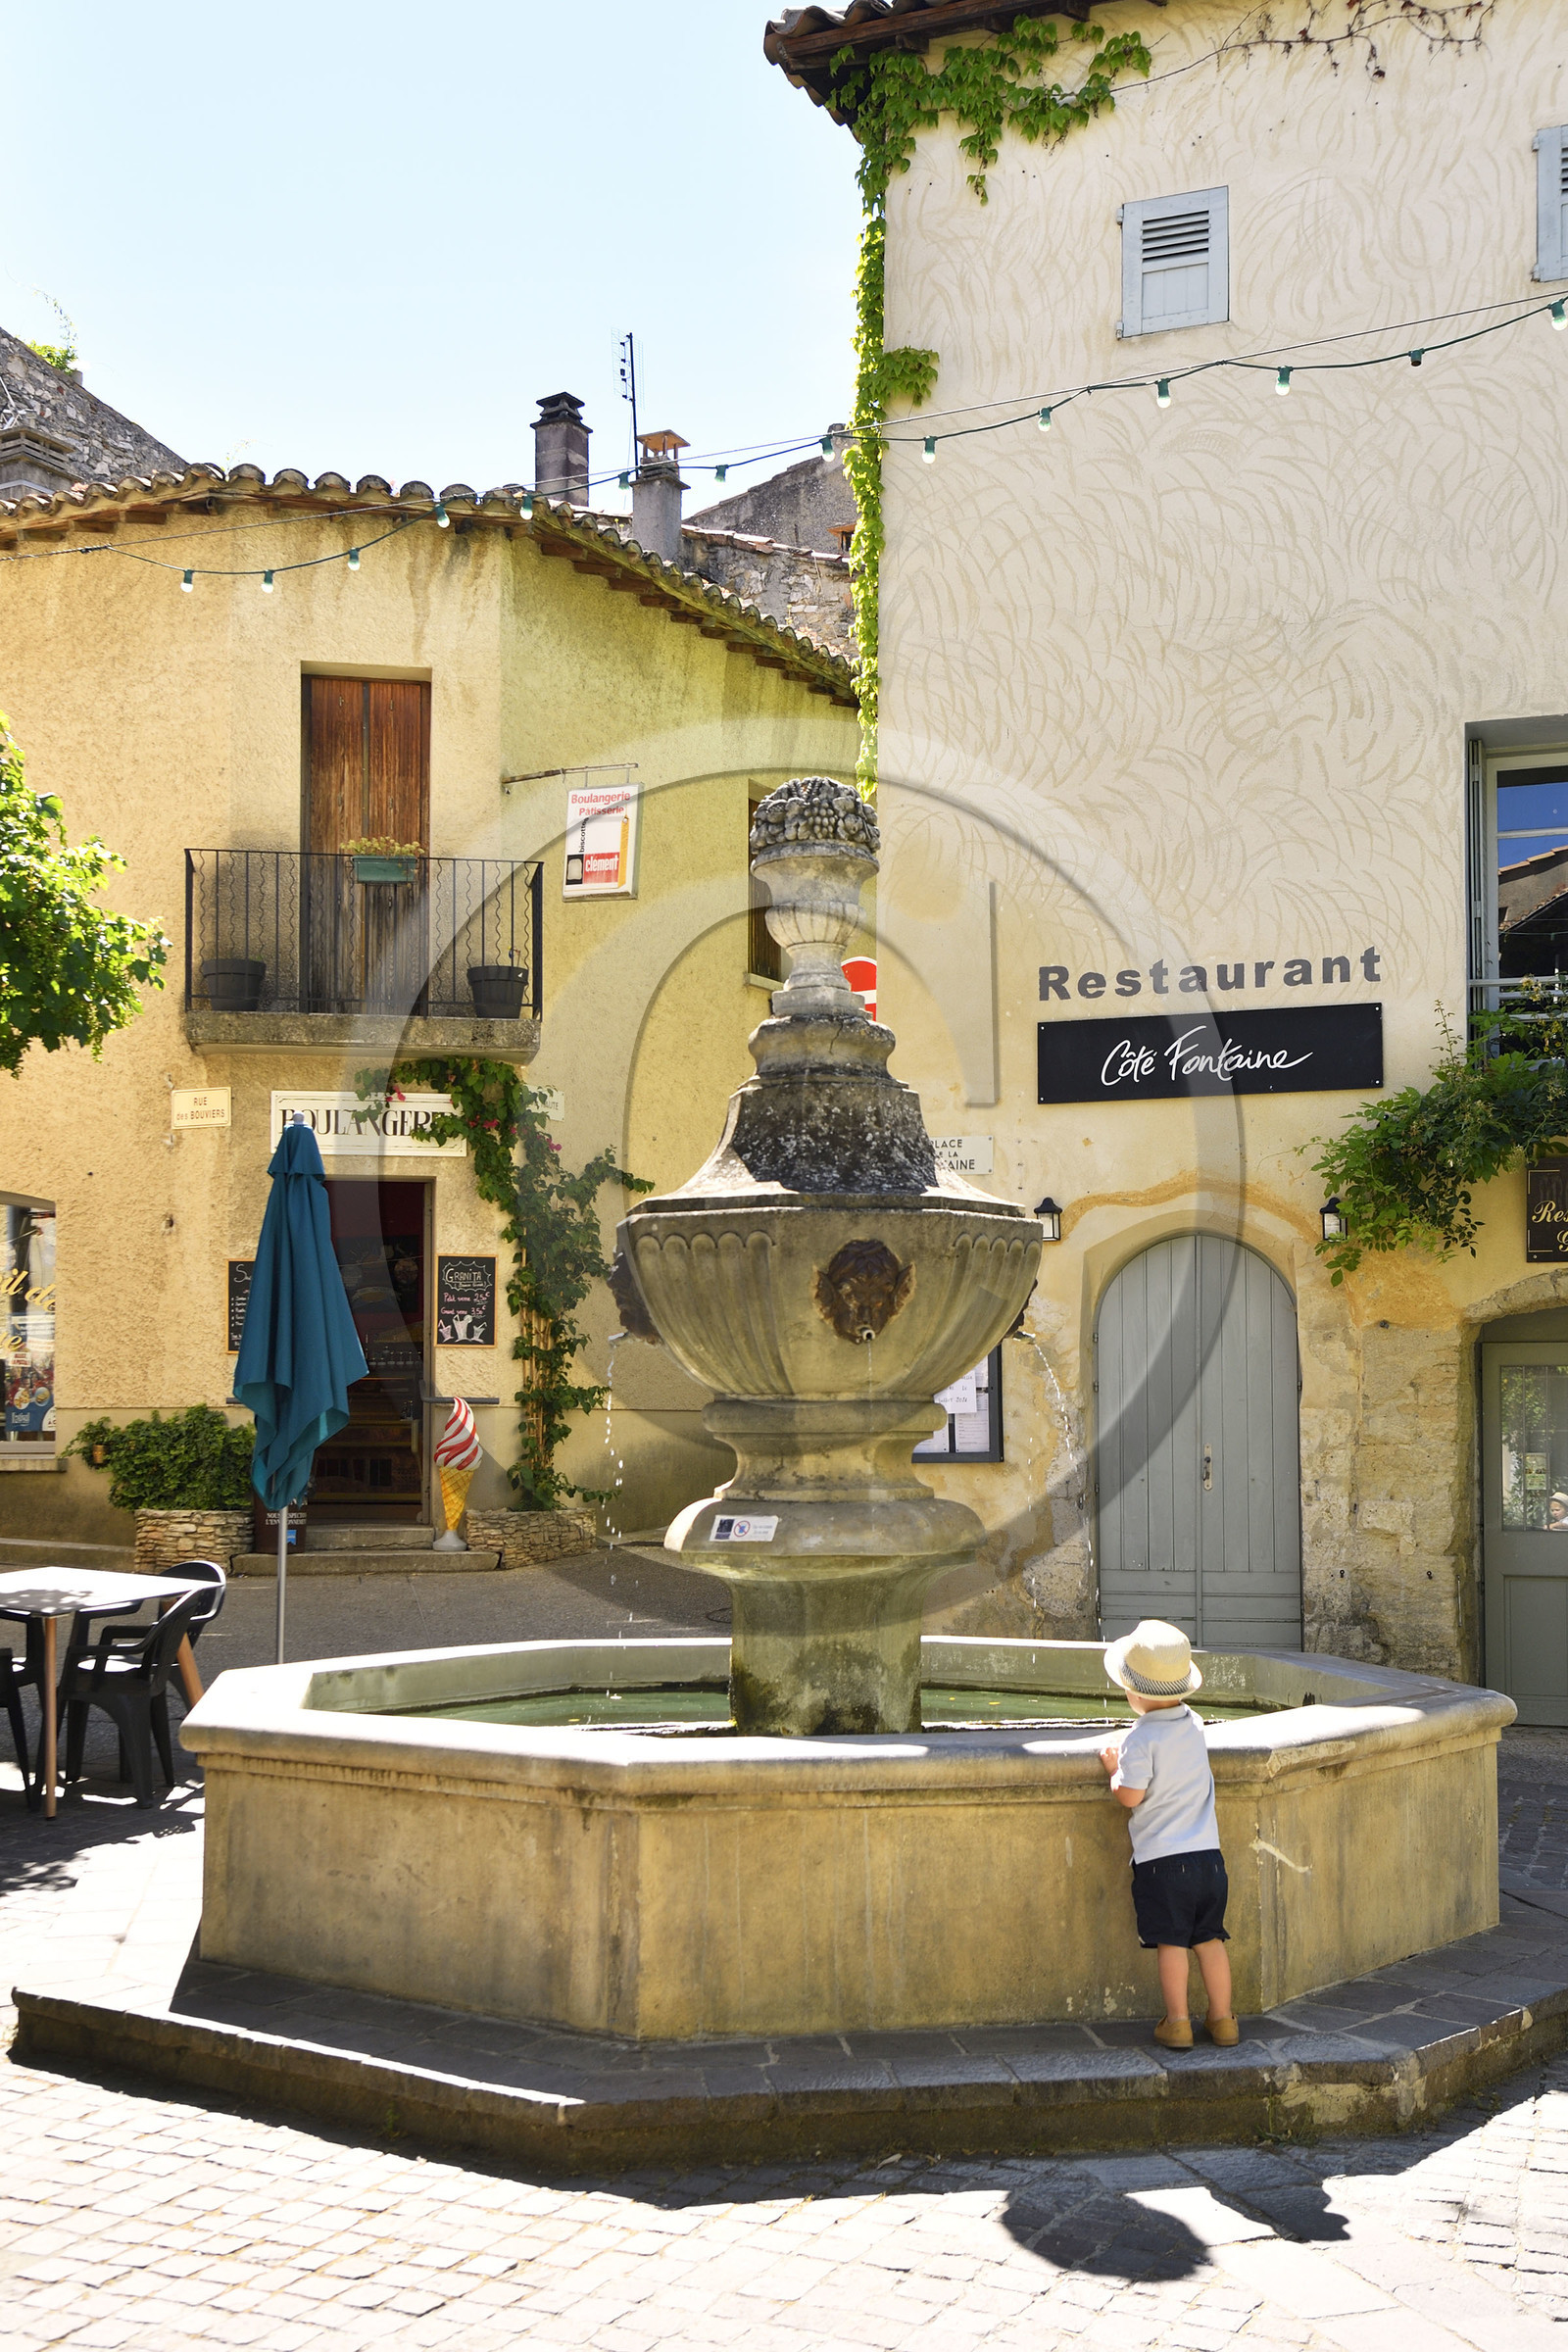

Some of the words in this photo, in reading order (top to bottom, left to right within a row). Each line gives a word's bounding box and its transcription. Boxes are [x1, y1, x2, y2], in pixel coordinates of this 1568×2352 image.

[571, 791, 630, 805] Boulangerie
[579, 806, 624, 815] Pâtisserie
[578, 817, 589, 853] biscottes
[585, 854, 619, 872] clément
[1038, 946, 1381, 1002] Restaurant
[1101, 1039, 1156, 1086] Côté
[1164, 1025, 1313, 1081] Fontaine
[193, 1097, 208, 1105] RUE
[190, 1108, 225, 1119] BOUVIERS
[278, 1108, 458, 1137] BOULANGER
